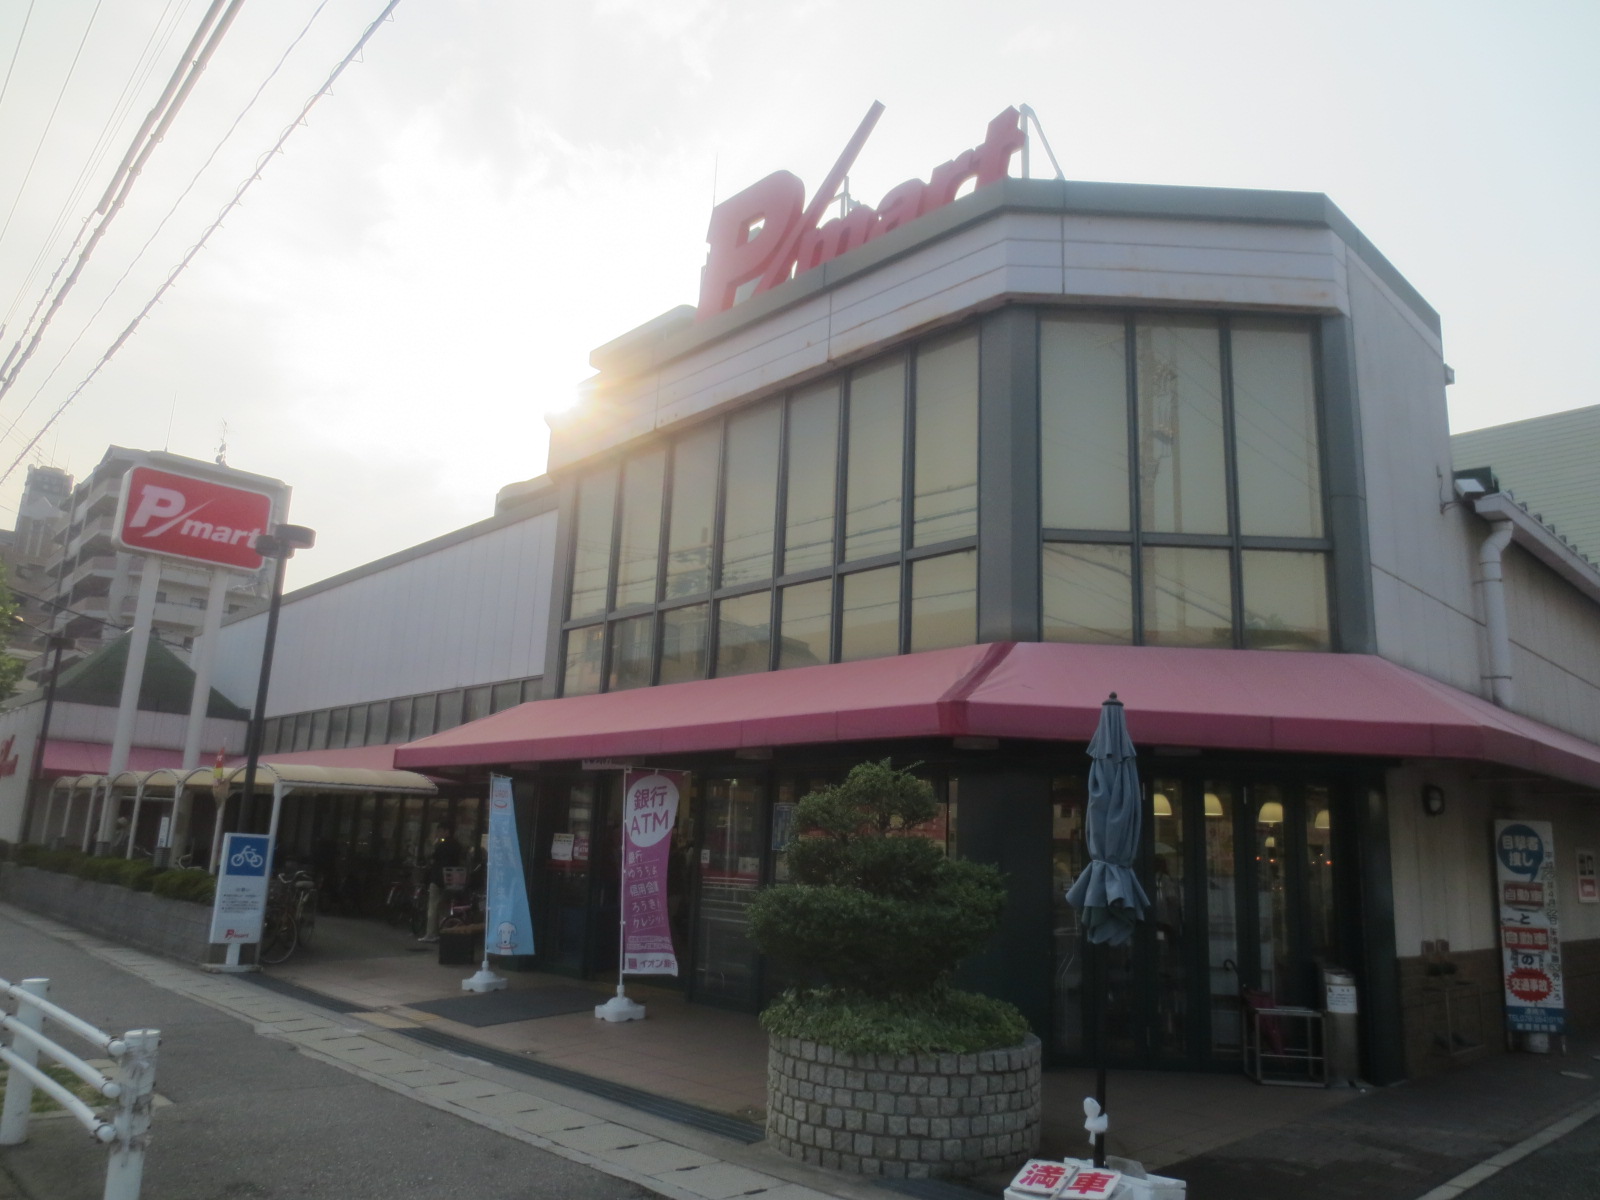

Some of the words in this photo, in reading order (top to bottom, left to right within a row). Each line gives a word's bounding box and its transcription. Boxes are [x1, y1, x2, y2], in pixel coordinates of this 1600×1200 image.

[634, 786, 668, 811] 銀行
[631, 809, 669, 836] ATM
[1520, 912, 1531, 925] と
[1521, 954, 1534, 966] の
[1019, 1163, 1115, 1194] 満車
